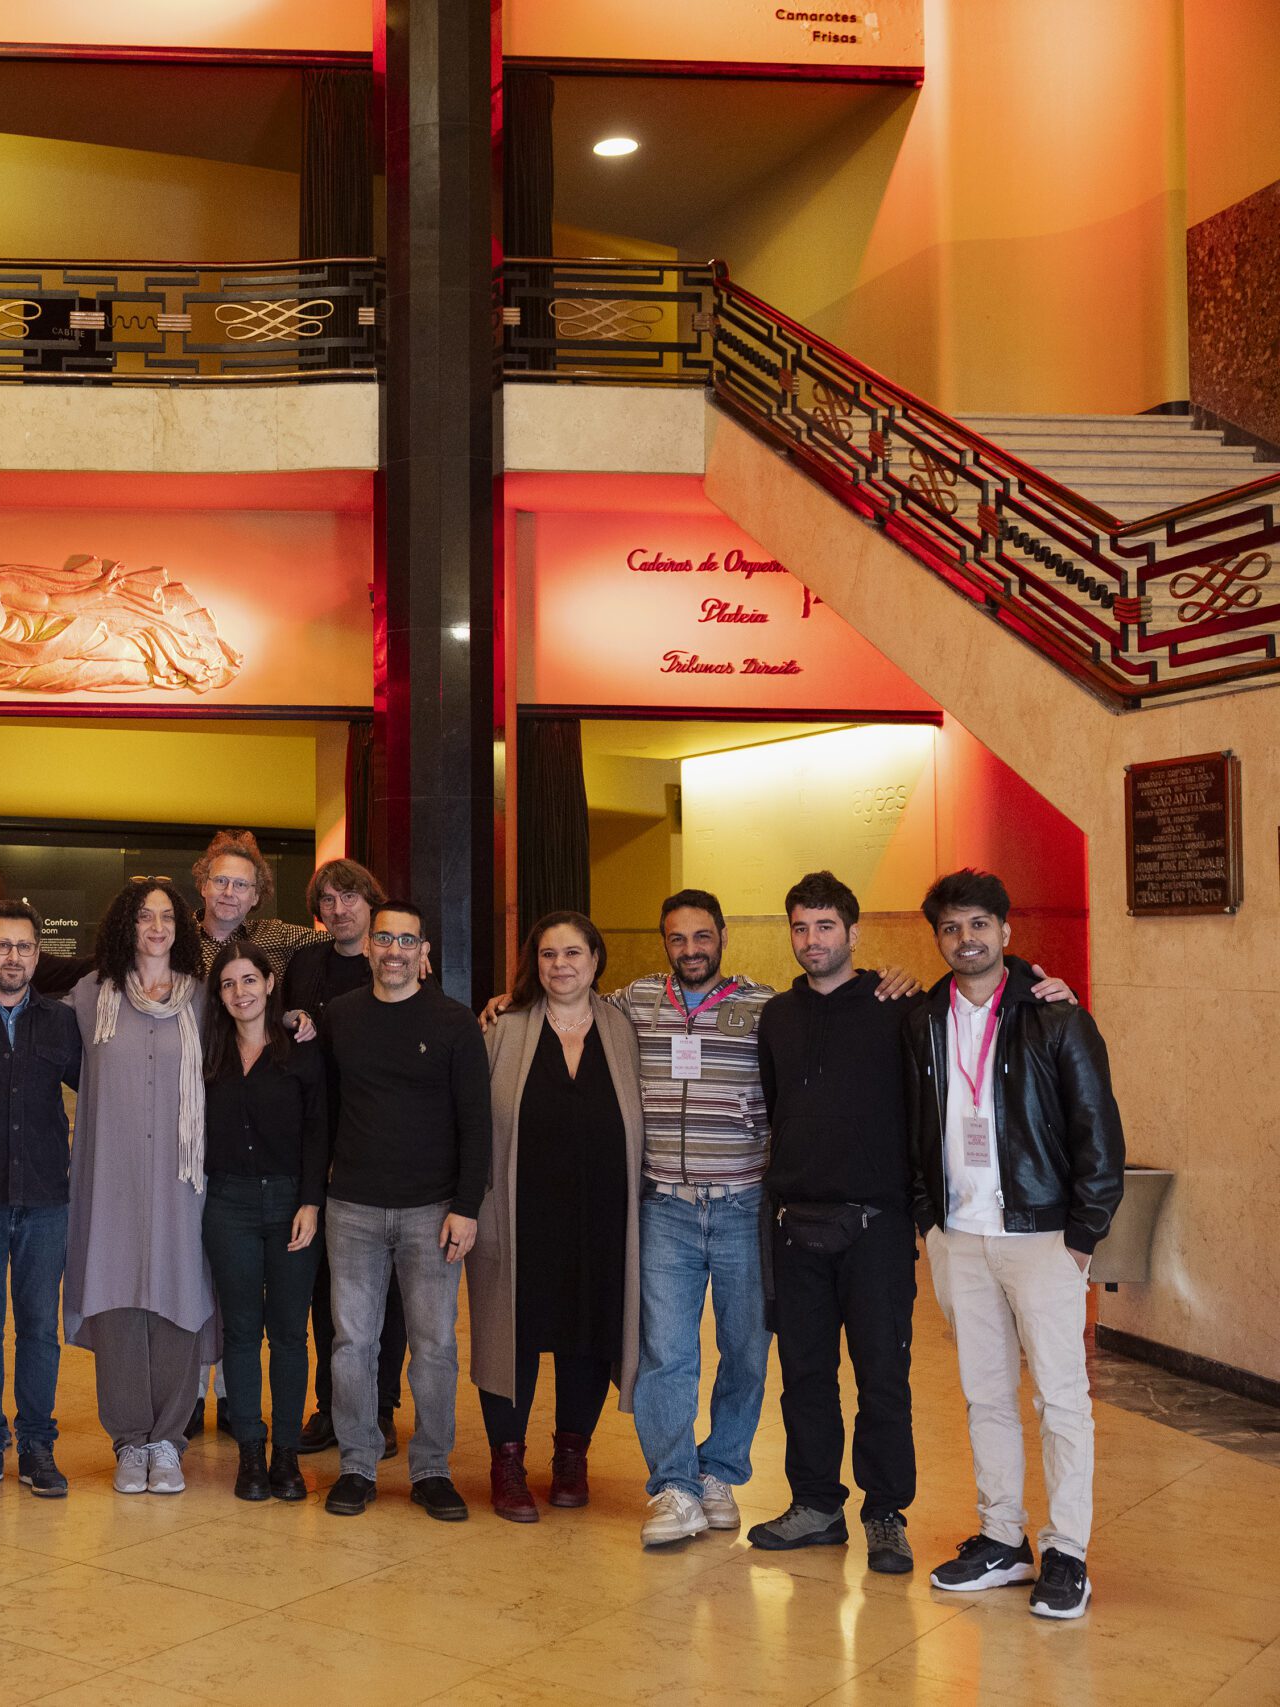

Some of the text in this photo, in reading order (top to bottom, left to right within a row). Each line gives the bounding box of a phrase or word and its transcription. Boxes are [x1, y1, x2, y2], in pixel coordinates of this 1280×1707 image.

[775, 9, 857, 23] Camarotes
[812, 30, 857, 44] Frisas
[51, 327, 86, 338] CABIE
[627, 548, 693, 572] Cadeiras
[696, 552, 720, 572] de
[697, 598, 770, 624] Plateia
[660, 650, 734, 674] Tribunas
[44, 918, 78, 926] Conforto
